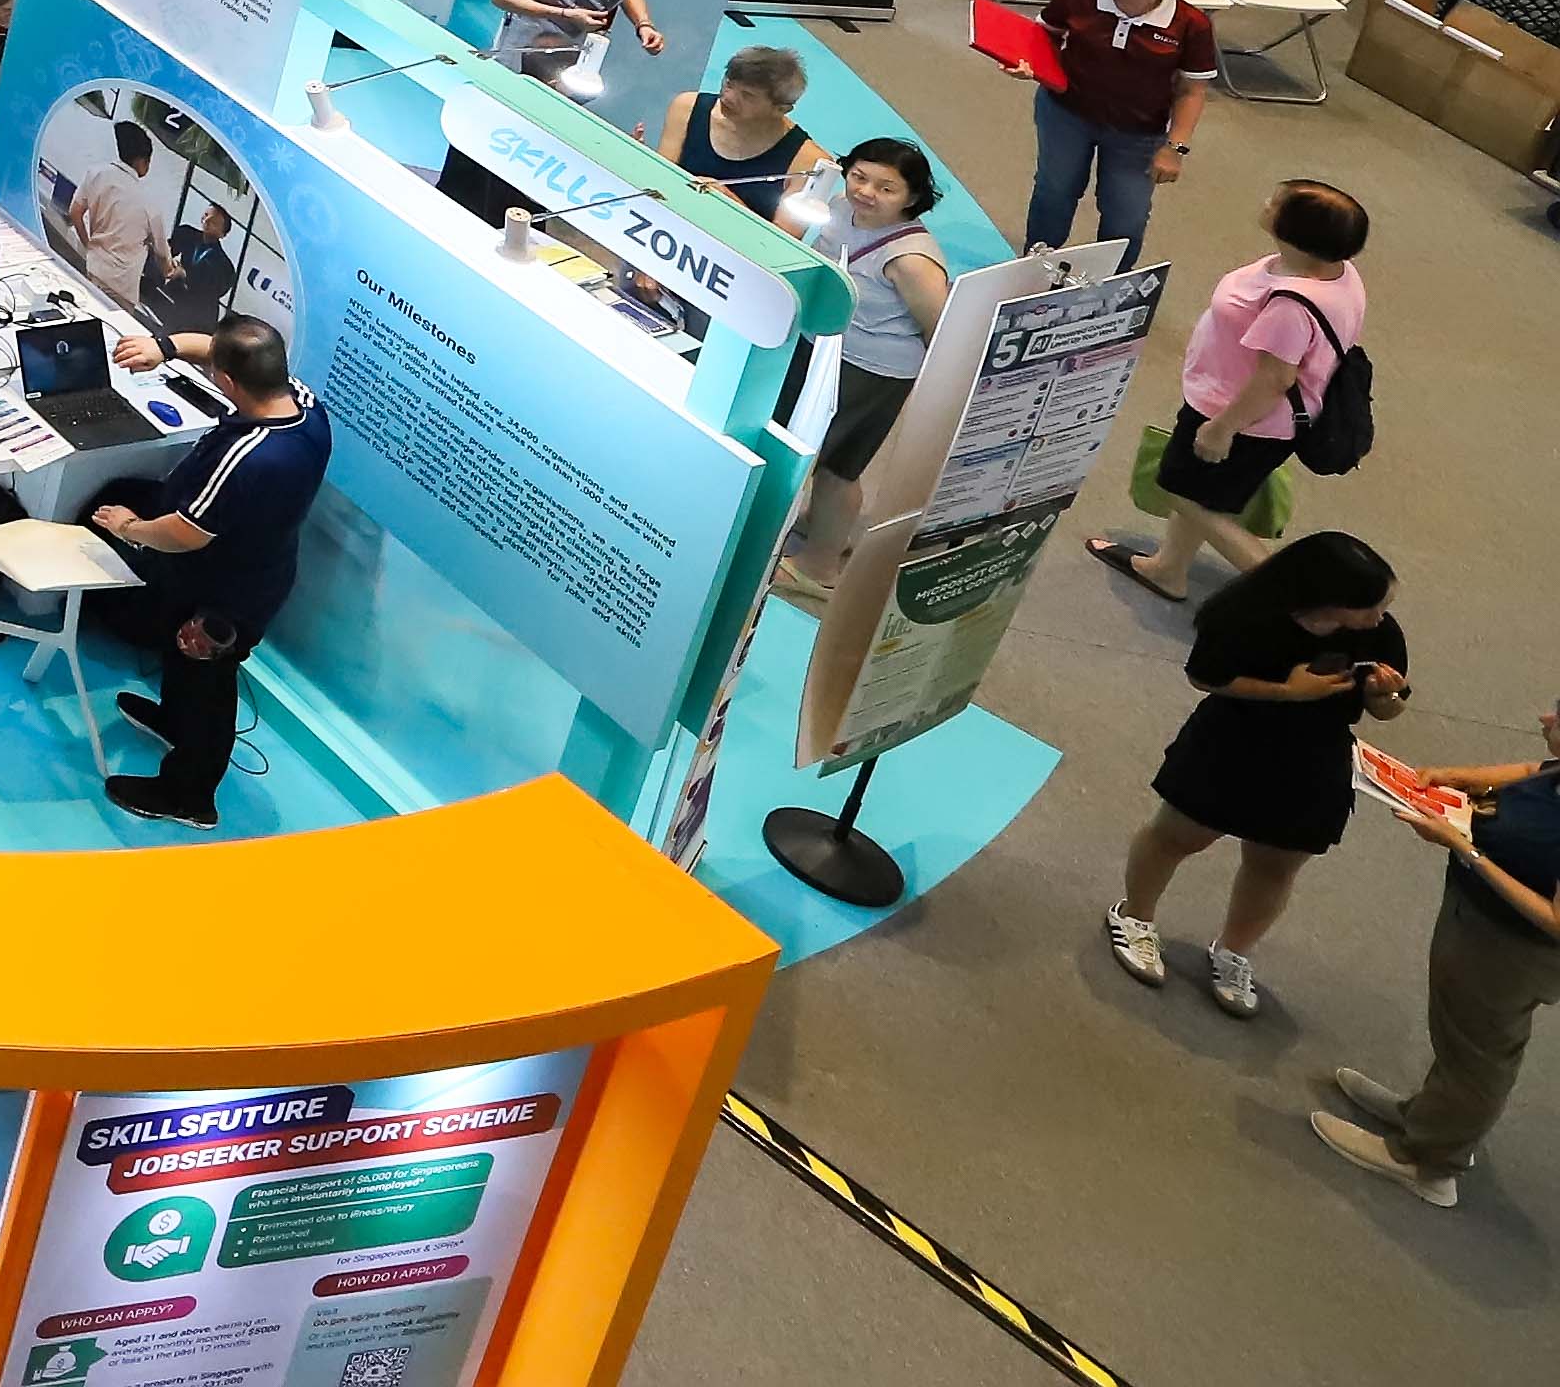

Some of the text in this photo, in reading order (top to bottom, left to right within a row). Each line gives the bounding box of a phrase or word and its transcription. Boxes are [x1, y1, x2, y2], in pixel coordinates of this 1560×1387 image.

[489, 128, 735, 301] SKILLS ZONE
[356, 269, 477, 365] Our Milestones
[86, 1096, 327, 1150] SKILLSFUTURE
[123, 1103, 536, 1180] JOBSEEKER SUPPORT SCHEME
